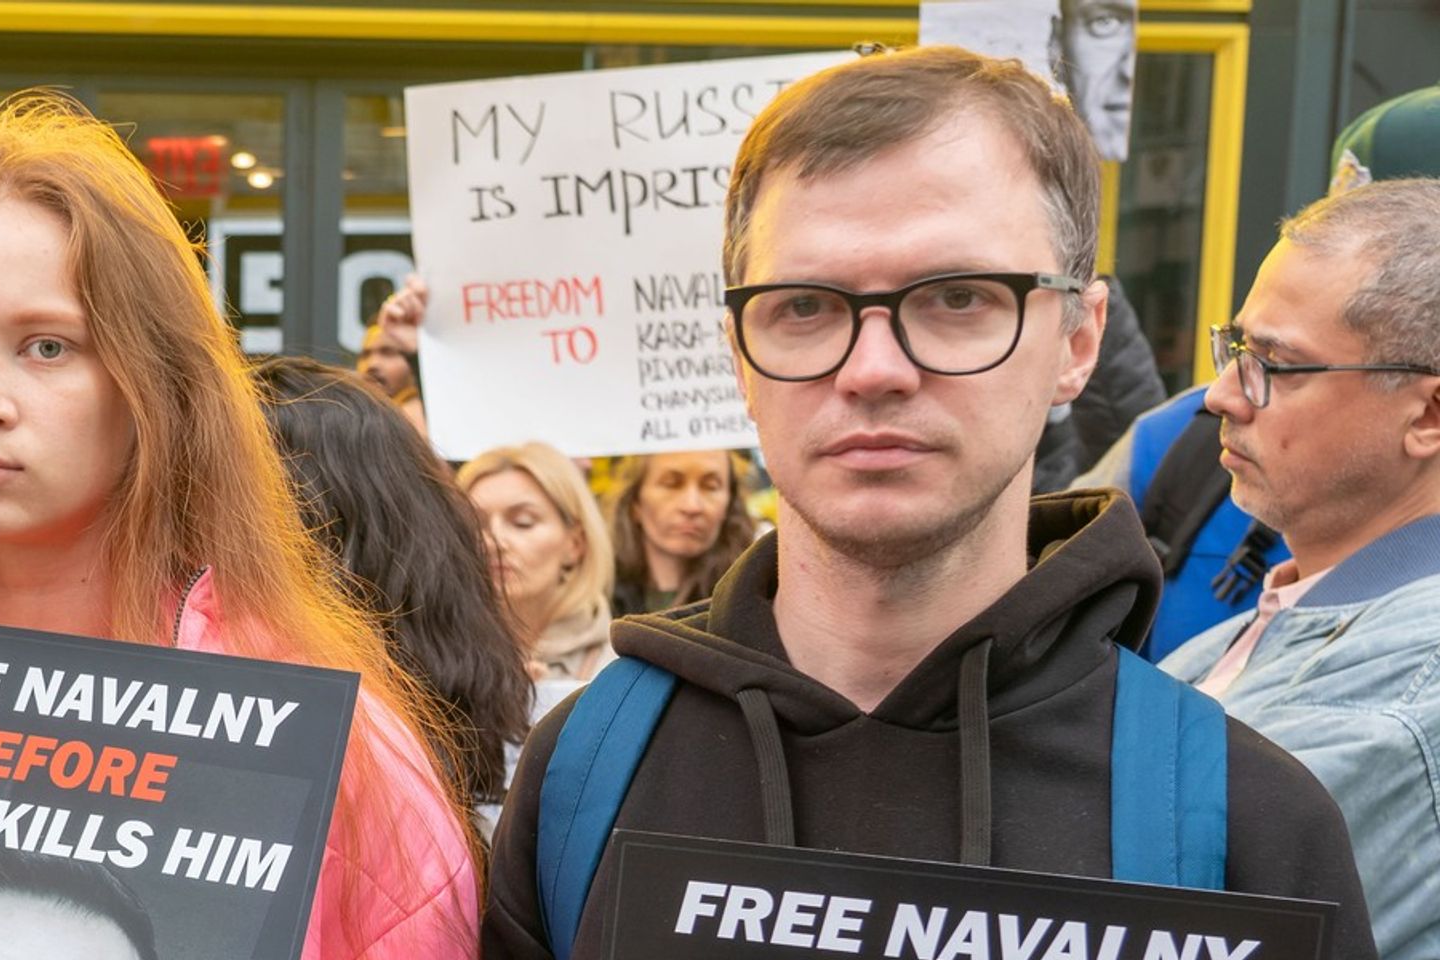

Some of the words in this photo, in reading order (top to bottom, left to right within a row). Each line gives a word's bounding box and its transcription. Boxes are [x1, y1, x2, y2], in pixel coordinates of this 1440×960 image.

[450, 101, 546, 166] MY
[469, 184, 517, 222] IS
[460, 273, 605, 324] FREEDOM
[542, 325, 599, 365] TO
[640, 417, 680, 441] ALL
[13, 667, 300, 747] NAVALNY
[161, 828, 293, 892] HIM
[675, 880, 873, 954] FREE
